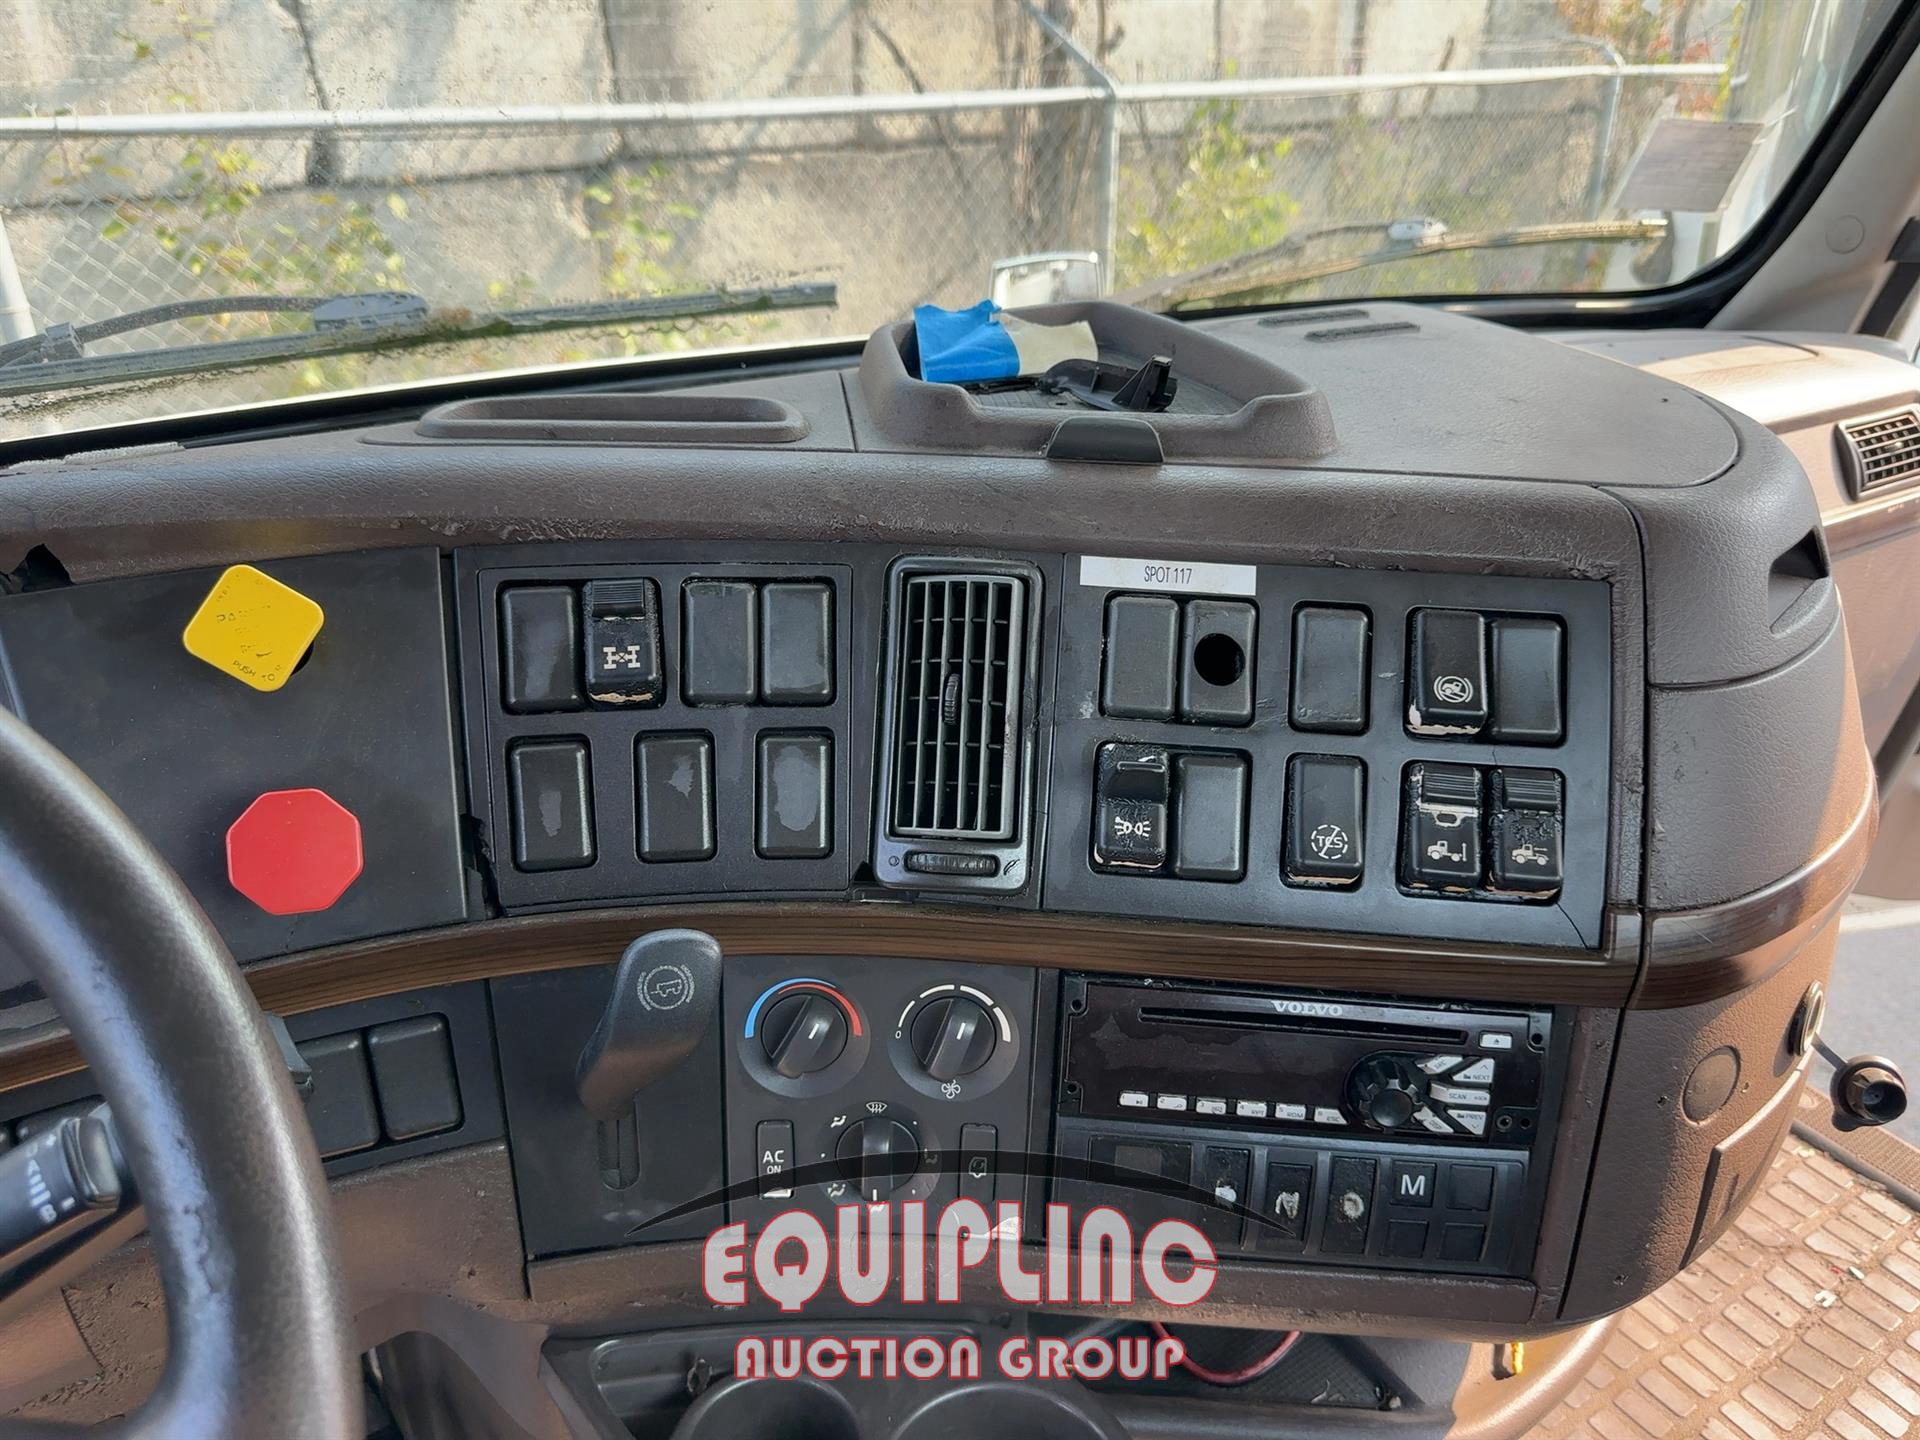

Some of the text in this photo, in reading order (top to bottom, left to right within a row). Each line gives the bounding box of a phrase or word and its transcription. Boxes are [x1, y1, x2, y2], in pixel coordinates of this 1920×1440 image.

[1144, 565, 1192, 584] SPOT 117
[233, 660, 256, 676] PUSH
[1316, 835, 1343, 848] TCS
[1271, 1000, 1343, 1017] VOLVO
[1448, 1092, 1467, 1100] SCAN
[762, 1150, 785, 1164] AC
[767, 1165, 782, 1174] ON
[1401, 1174, 1426, 1196] M
